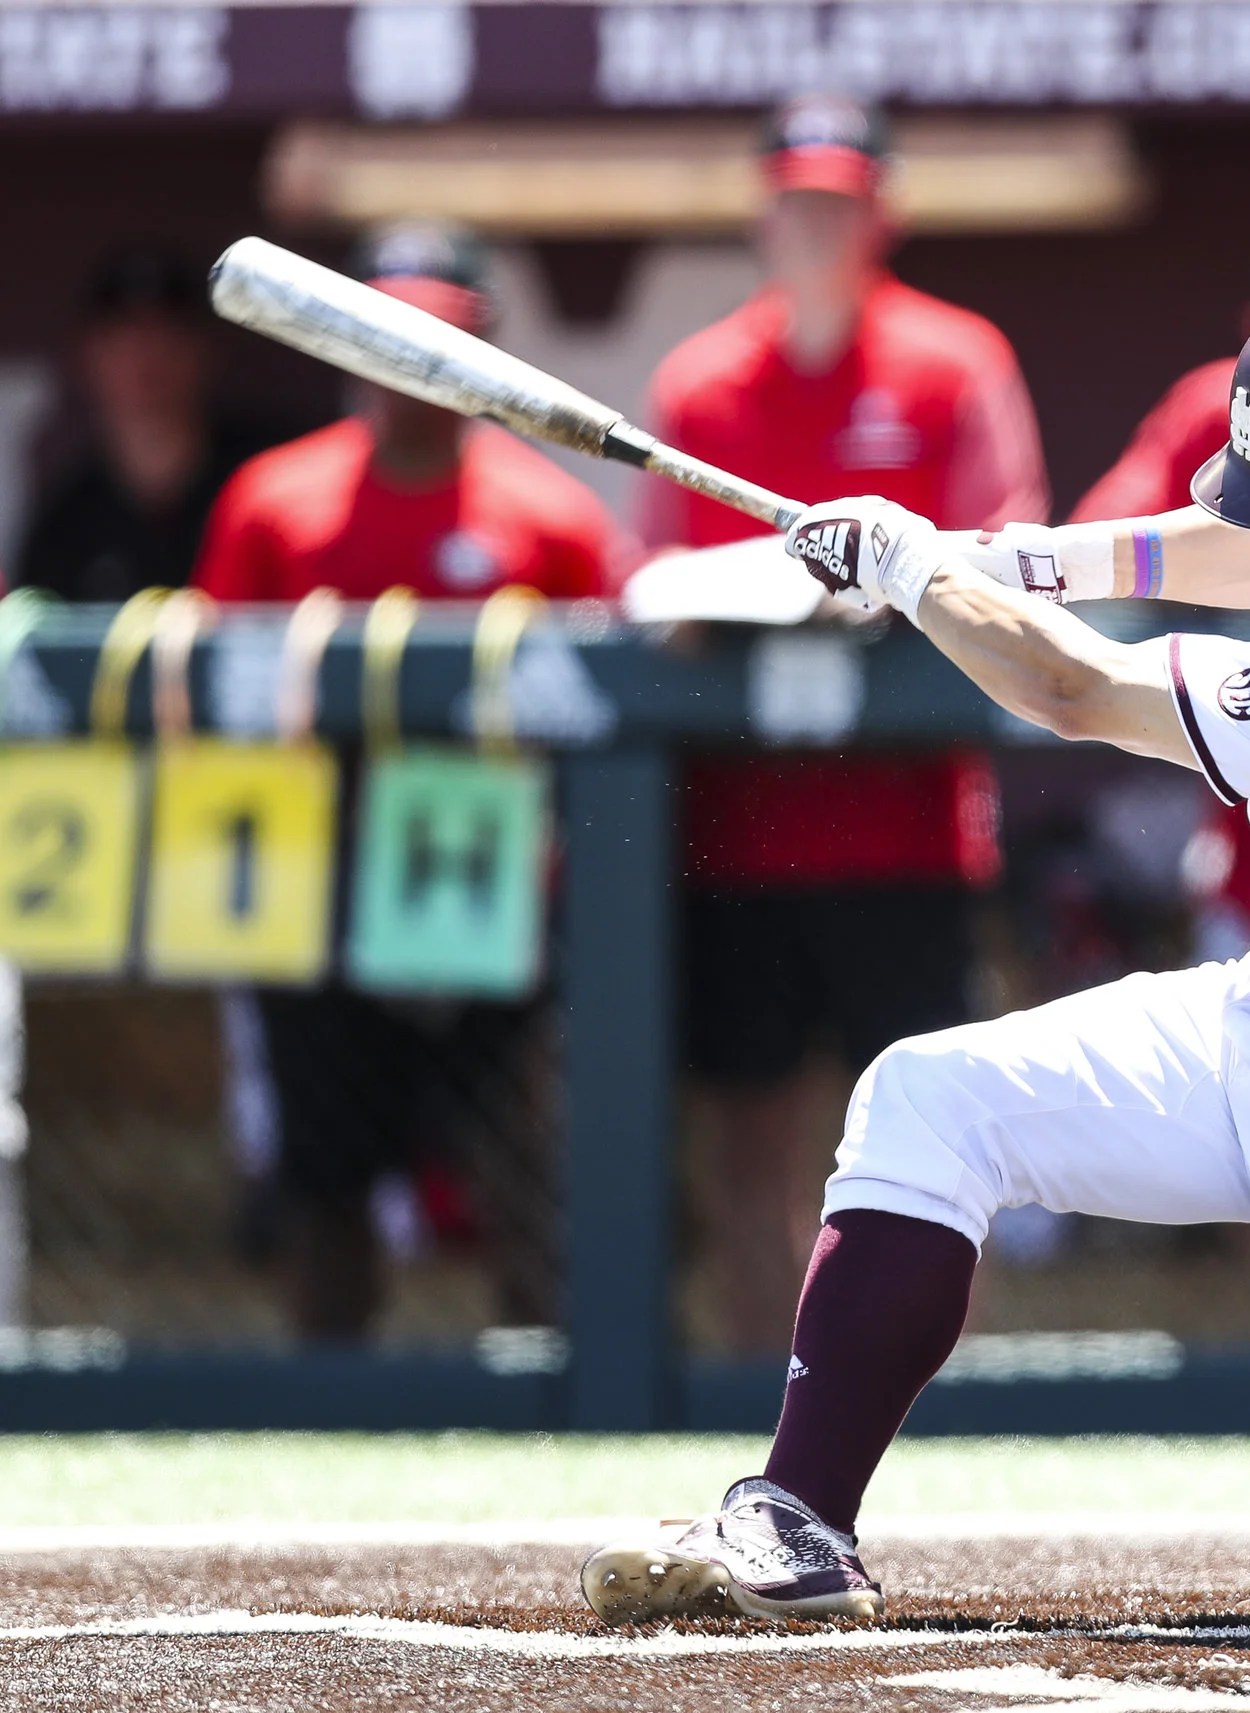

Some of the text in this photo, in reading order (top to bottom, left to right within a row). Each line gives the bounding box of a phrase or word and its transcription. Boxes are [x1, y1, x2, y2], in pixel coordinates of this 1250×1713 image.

[794, 536, 850, 581] adidas
[8, 806, 88, 916] 2
[221, 802, 260, 922] 1
[398, 808, 502, 918] H
